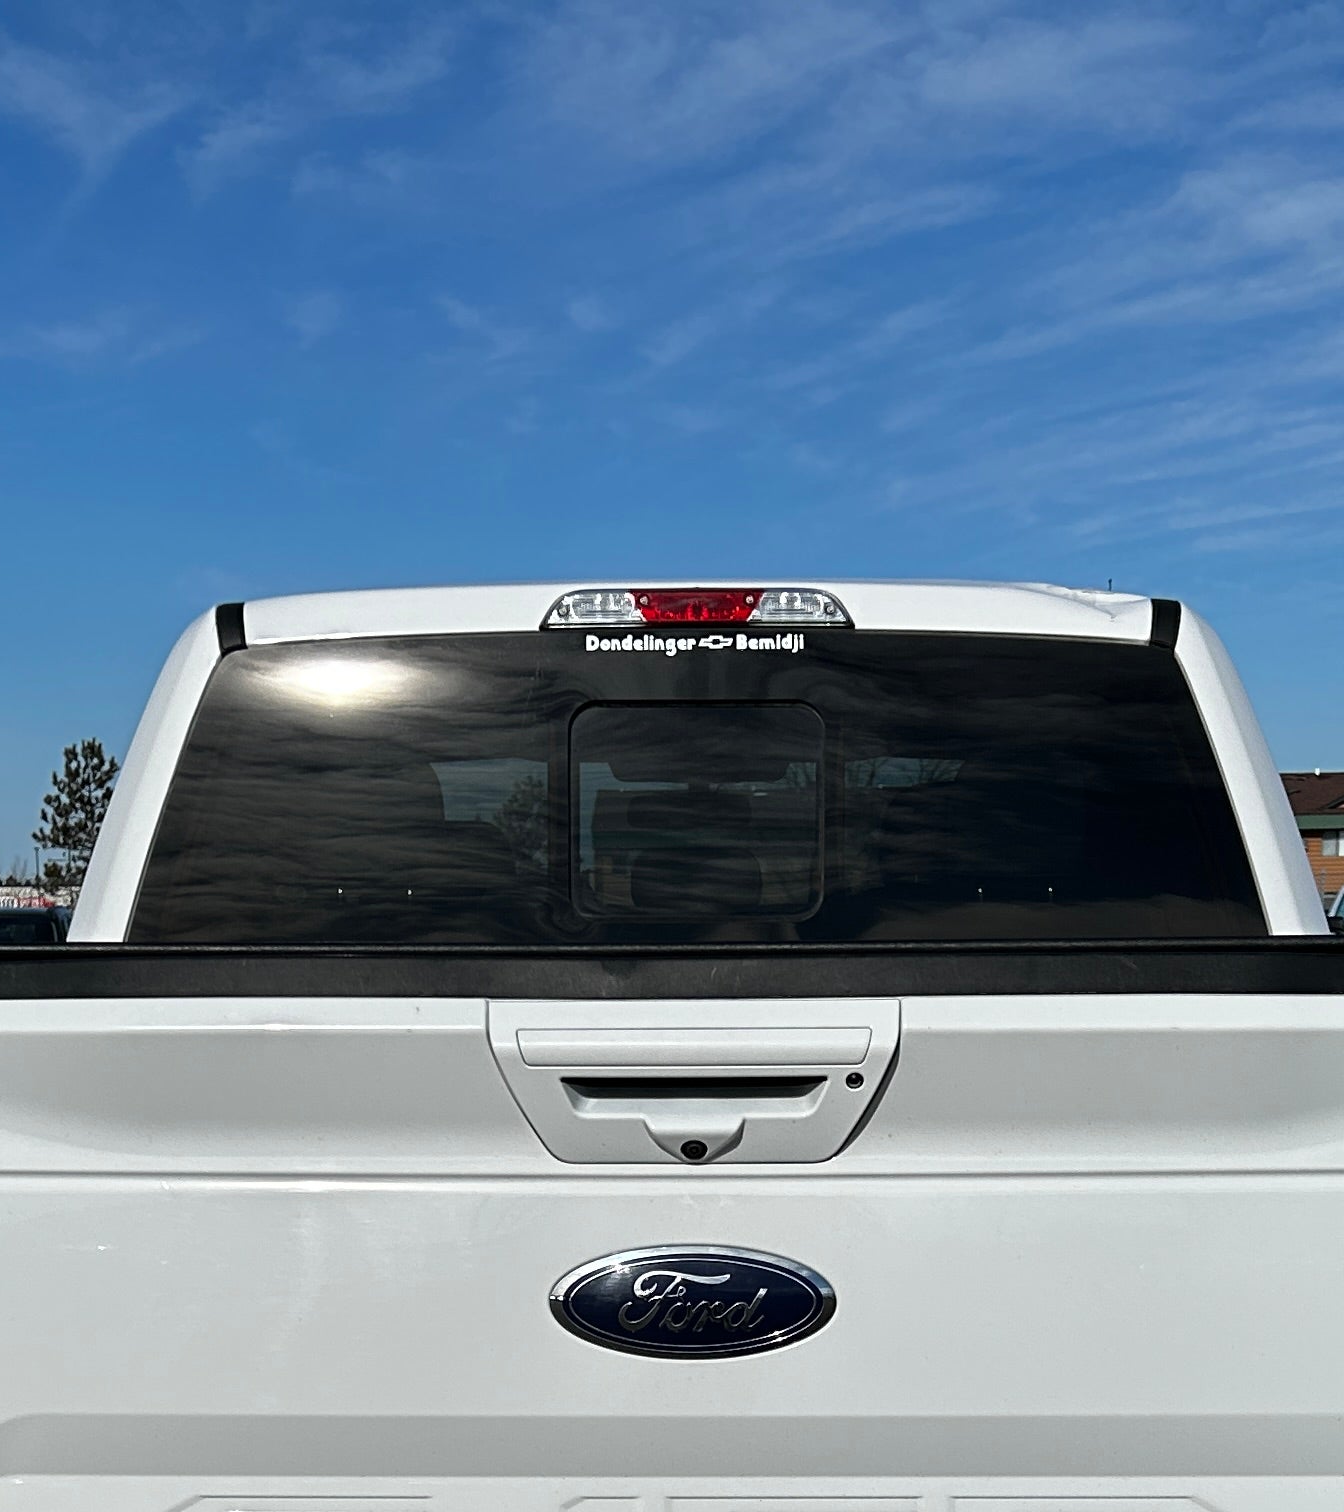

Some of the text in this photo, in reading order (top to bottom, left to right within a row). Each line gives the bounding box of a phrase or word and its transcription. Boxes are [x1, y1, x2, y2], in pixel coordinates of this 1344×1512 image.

[585, 633, 805, 656] Dondelinger Bemidji
[618, 1270, 768, 1333] Ford
